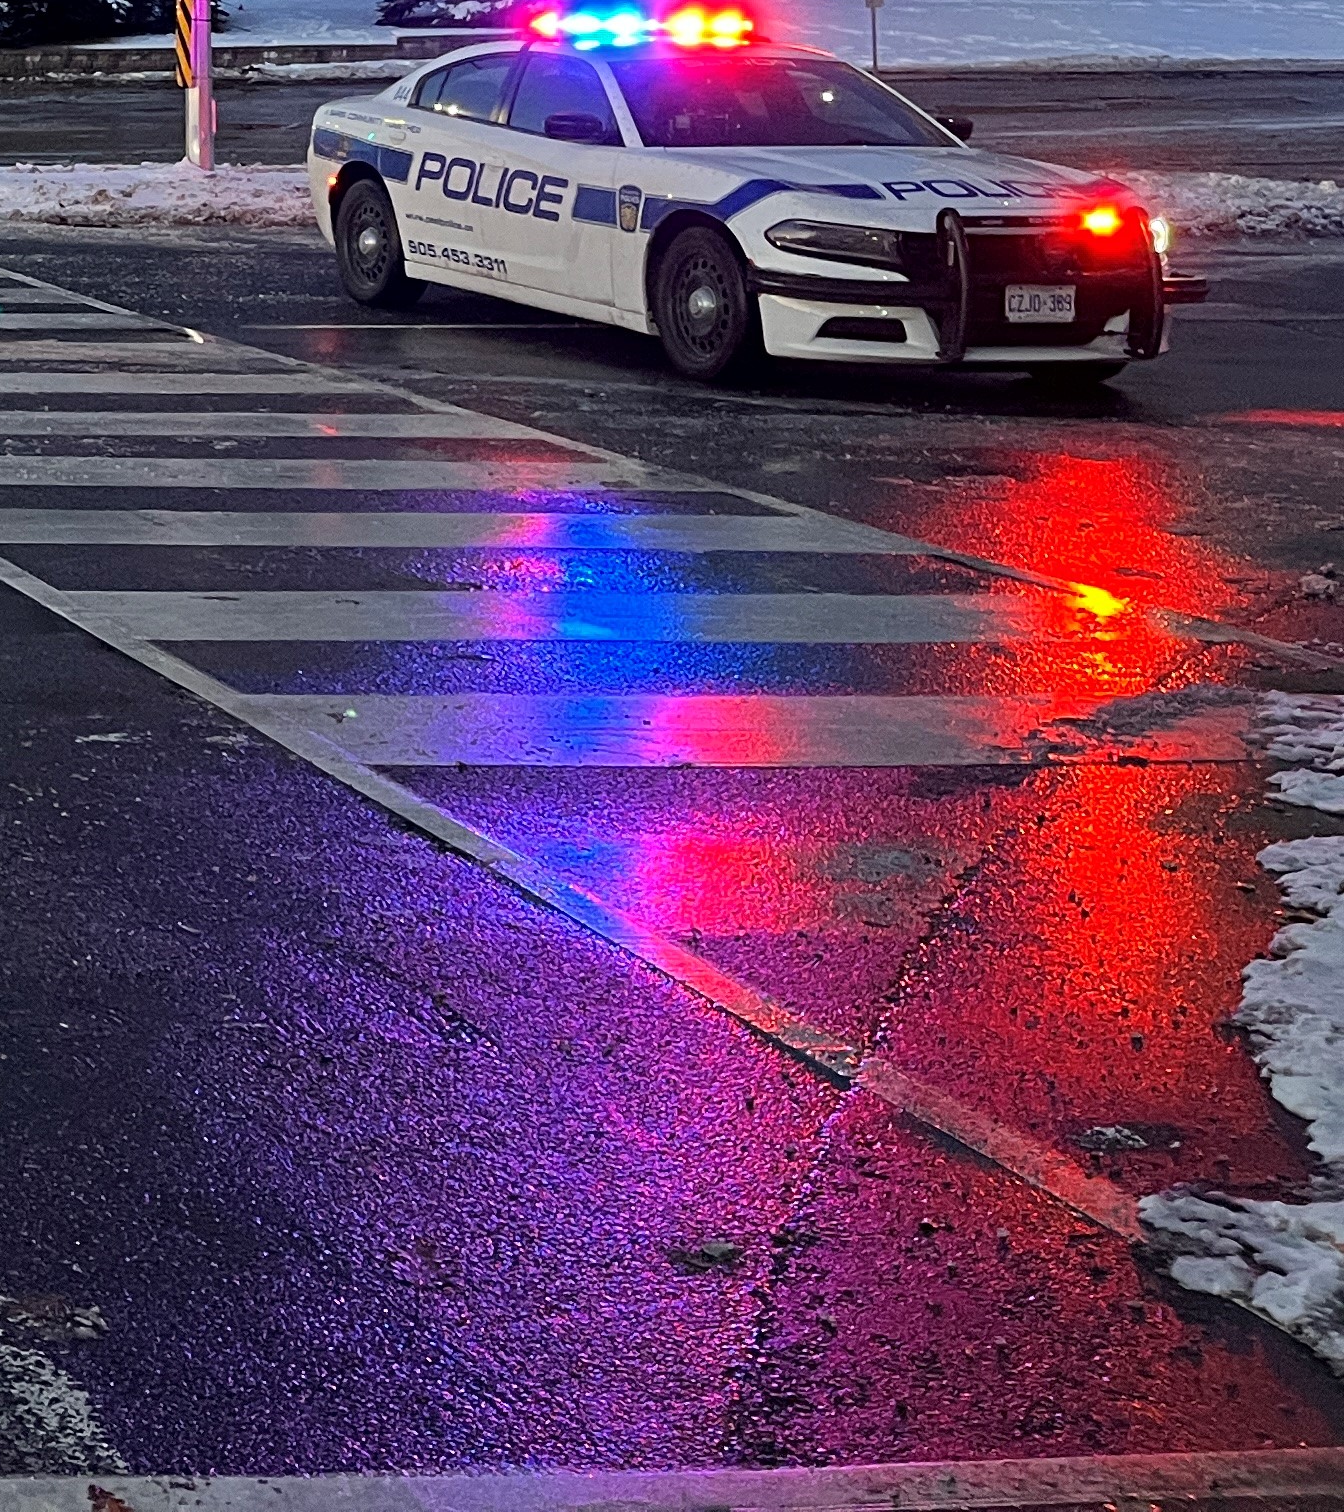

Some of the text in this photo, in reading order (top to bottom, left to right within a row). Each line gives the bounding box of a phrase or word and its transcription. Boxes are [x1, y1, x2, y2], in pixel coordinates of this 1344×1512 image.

[415, 151, 569, 222] POLICE
[882, 179, 1088, 201] POLICE
[408, 239, 508, 274] 905.453.3311
